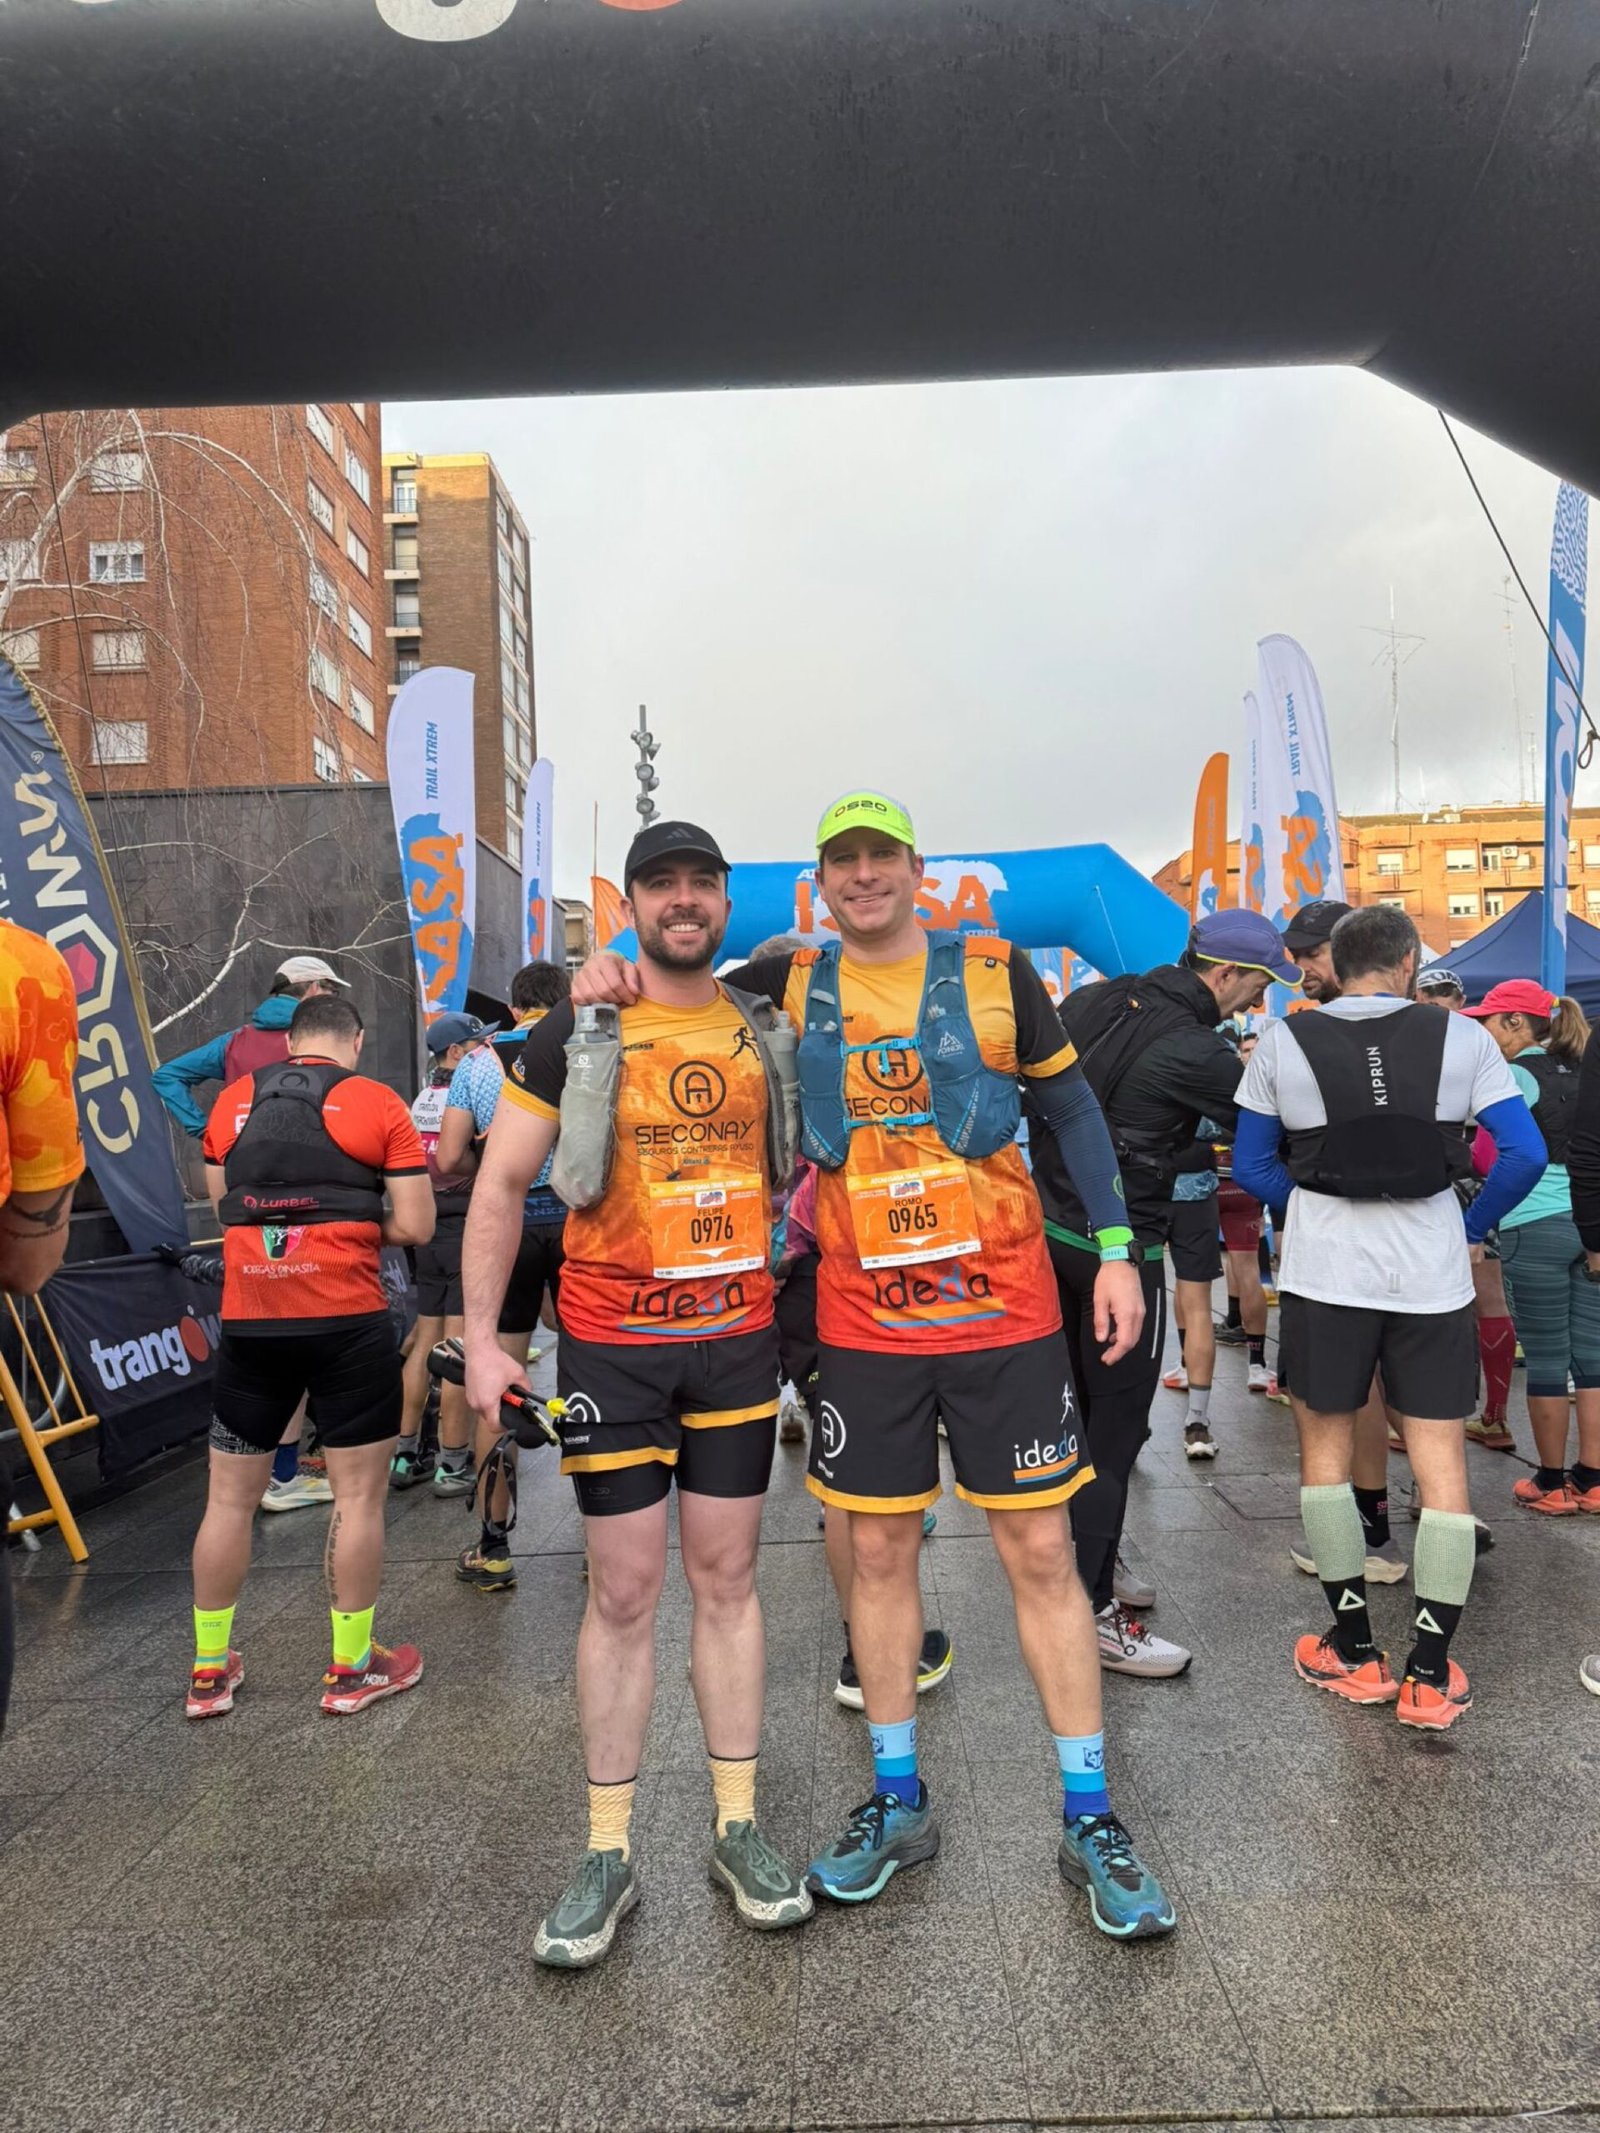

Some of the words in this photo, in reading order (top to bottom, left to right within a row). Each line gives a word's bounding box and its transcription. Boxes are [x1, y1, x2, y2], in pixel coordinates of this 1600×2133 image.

[425, 721, 438, 763] XTREM
[426, 761, 438, 800] TRAIL
[1367, 1045, 1388, 1106] KIPRUN
[635, 1120, 756, 1146] SECONAY
[637, 1145, 679, 1157] SEGUROS
[697, 1207, 725, 1217] FELIPE
[895, 1197, 922, 1207] ROMO
[691, 1214, 734, 1244] 0976
[888, 1203, 938, 1233] 0965
[872, 1263, 994, 1311] ideda
[1014, 1429, 1078, 1469] ideda
[361, 1672, 389, 1685] HOKA
